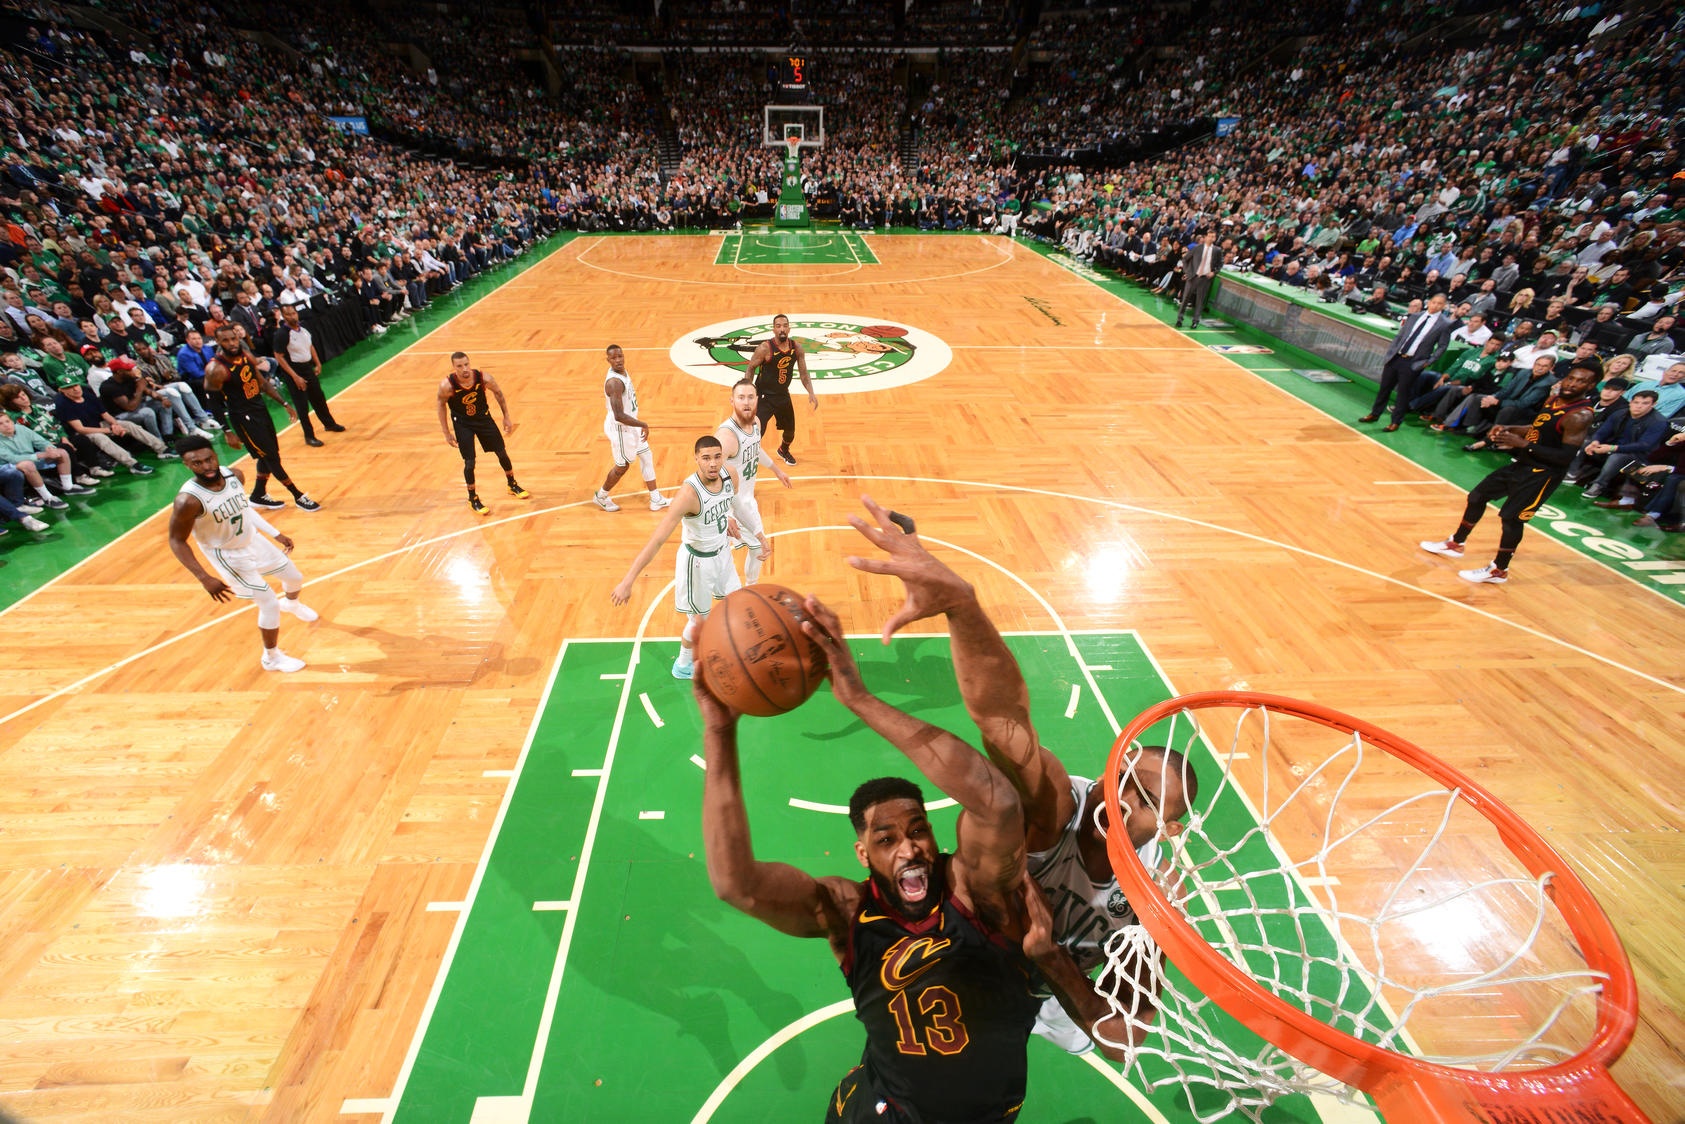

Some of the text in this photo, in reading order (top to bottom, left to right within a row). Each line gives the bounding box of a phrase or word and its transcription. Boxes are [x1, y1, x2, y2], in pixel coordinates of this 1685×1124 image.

[794, 67, 802, 82] 5
[778, 368, 788, 384] 5
[466, 404, 477, 416] 3
[742, 457, 760, 481] 46
[212, 492, 249, 524] CELTICS
[230, 514, 243, 537] 7
[888, 985, 970, 1056] 13
